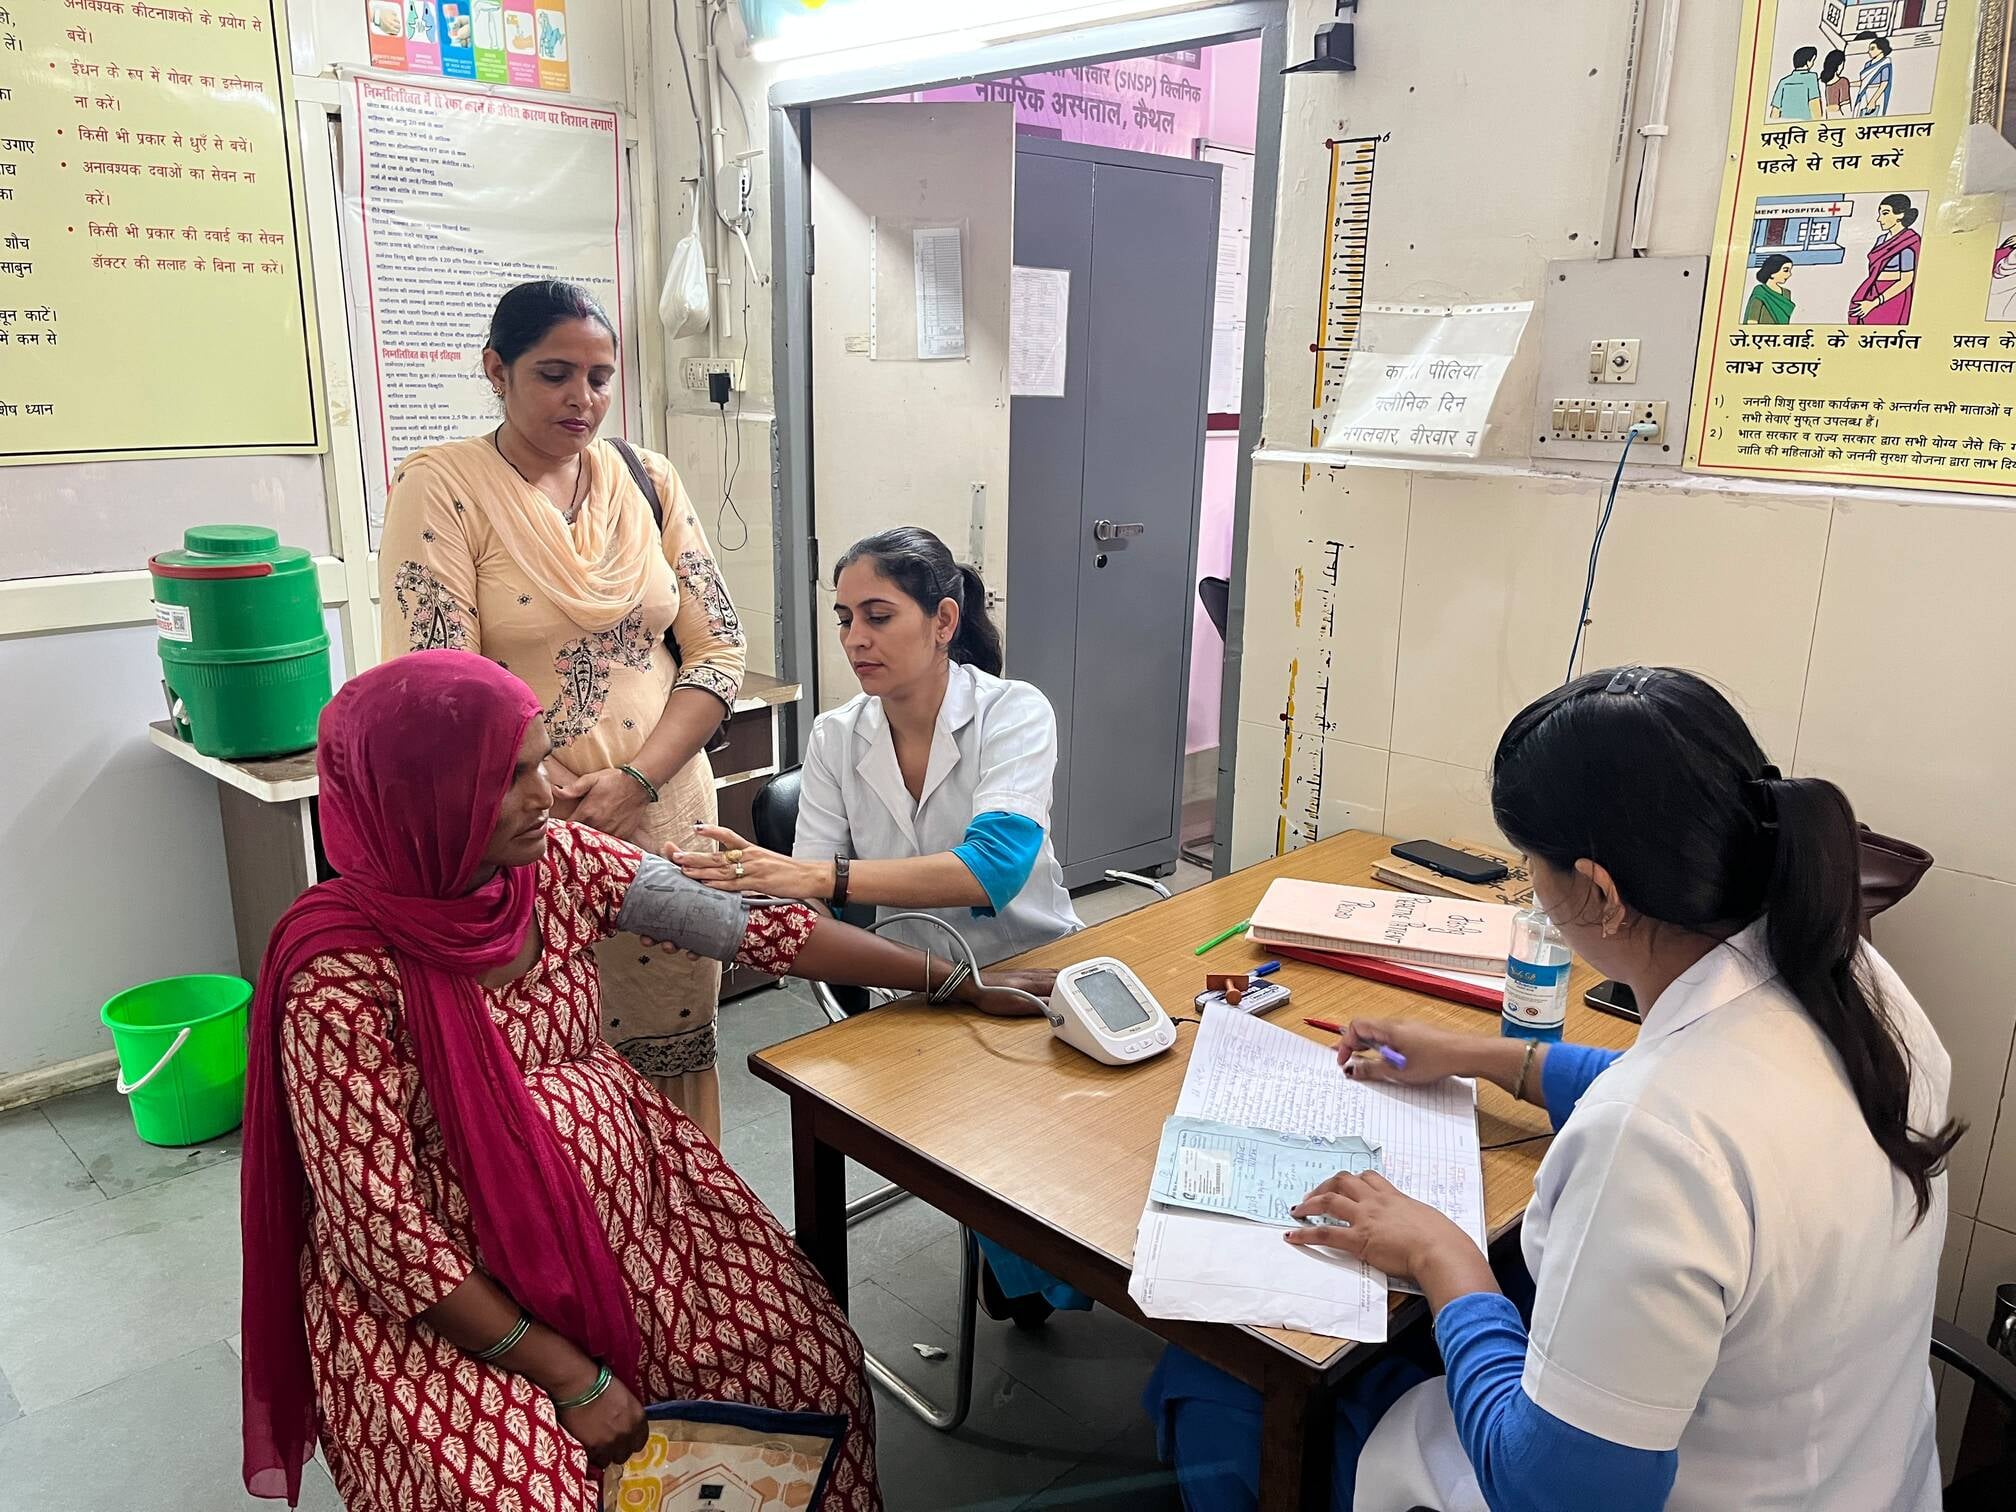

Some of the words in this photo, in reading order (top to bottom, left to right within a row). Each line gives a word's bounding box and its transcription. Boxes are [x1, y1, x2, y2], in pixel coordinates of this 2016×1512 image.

[64, 0, 125, 14] अनावश्यक
[131, 2, 193, 23] कीटनाशकों
[199, 9, 212, 25] के
[218, 16, 246, 30] प्रयोग
[251, 16, 262, 32] से
[3, 33, 23, 51] लें।
[66, 25, 93, 44] बचें।
[105, 62, 120, 78] के
[126, 68, 144, 81] रूप
[149, 66, 160, 83] में
[166, 68, 193, 85] गोबर
[199, 76, 215, 88] का
[221, 77, 263, 93] इस्तेमाल
[1114, 69, 1157, 95] (SNSP)
[1160, 78, 1202, 103] क्लिनिक
[74, 96, 88, 108] ना
[95, 94, 120, 111] करें।
[363, 82, 421, 109] निम्नलिखित
[522, 108, 546, 122] कारण
[548, 112, 559, 124] पर
[560, 111, 589, 128] निशान
[590, 113, 613, 132] लगाएं
[975, 80, 1045, 113] नागरिक
[1051, 92, 1127, 130] अस्पताल,
[1132, 97, 1175, 134] कैथल
[2, 138, 35, 154] उगाए
[78, 124, 108, 142] किसी
[115, 128, 130, 143] भी
[136, 133, 166, 146] प्रकार
[172, 131, 183, 148] से
[190, 133, 207, 153] धुएँ
[213, 134, 224, 151] से
[229, 136, 253, 153] बचें।
[1382, 132, 1391, 142] 6
[1761, 126, 1809, 150] प्रसूति
[1817, 123, 1846, 147] हेतु
[1855, 122, 1935, 140] अस्पताल
[1757, 154, 1798, 174] पहले
[1806, 152, 1823, 171] से
[1832, 155, 1862, 170] तय
[1871, 148, 1904, 168] करें
[83, 161, 142, 176] अनावश्यक
[148, 162, 182, 179] दवाओं
[188, 168, 205, 180] का
[210, 165, 237, 182] सेवन
[243, 172, 255, 183] ना
[85, 189, 110, 206] करें।
[4, 232, 30, 250] शौच
[88, 221, 118, 238] किसी
[125, 223, 139, 238] भी
[145, 228, 175, 240] प्रकार
[181, 226, 198, 241] की
[203, 227, 231, 243] दवाई
[237, 232, 253, 243] का
[258, 229, 284, 245] सेवन
[1334, 234, 1339, 242] 7
[0, 262, 33, 278] साबुन
[91, 253, 127, 269] डॉक्टर
[133, 254, 150, 270] की
[156, 259, 187, 271] सलाह
[193, 256, 206, 271] के
[213, 257, 236, 272] बिना
[241, 262, 254, 273] ना
[261, 259, 284, 275] करें।
[24, 305, 57, 322] काटें।
[16, 334, 39, 345] कम
[45, 329, 57, 345] से
[1729, 329, 1815, 350] जे.एस.वाई.
[1827, 329, 1849, 348] के
[1858, 329, 1922, 349] अंतर्गत
[1953, 335, 1990, 348] प्रसव
[1999, 331, 2016, 349] के
[1386, 365, 1418, 380] काा
[1429, 360, 1483, 380] पीलिया
[1725, 361, 1764, 374] लाभ
[1771, 358, 1821, 378] उठाएं
[1950, 359, 2016, 373] अस्पताल
[25, 404, 54, 415] ध्यान
[1437, 391, 1467, 412] दिन
[1715, 394, 1724, 408] 1)
[1742, 395, 1772, 407] जननी
[1774, 395, 1796, 411] शिशु
[1798, 399, 1826, 412] सुरक्षा
[1828, 397, 1870, 410] कार्यक्रम
[1873, 397, 1886, 411] के
[1889, 399, 1931, 413] अन्तर्गत
[1934, 401, 1957, 414] सभी
[1960, 402, 2001, 416] माताओं
[2003, 407, 2013, 417] व
[1742, 411, 1763, 423] सभी
[1823, 416, 1863, 427] उपलब्ध
[1865, 414, 1879, 428] हैं।
[1410, 424, 1460, 446] वीरवार
[1466, 431, 1478, 447] व
[1710, 426, 1722, 440] 2)
[1738, 429, 1763, 439] भारत
[1766, 431, 1799, 441] सरकार
[1802, 432, 1811, 441] व
[1814, 433, 1839, 443] राज्य
[1842, 434, 1877, 444] सरकार
[1881, 436, 1901, 446] द्वारा
[1905, 434, 1928, 447] सभी
[1932, 435, 1958, 449] योग्य
[1962, 436, 1984, 451] जैसे
[1989, 438, 2007, 452] कि
[1737, 443, 1762, 455] जाति
[1764, 444, 1779, 456] की
[1781, 445, 1826, 459] महिलाओं
[1828, 446, 1843, 460] को
[1846, 449, 1878, 462] जननी
[1880, 453, 1909, 465] सुरक्षा
[1911, 451, 1947, 466] योजना
[1949, 457, 1971, 467] द्वारा
[1973, 458, 1998, 469] लाभ
